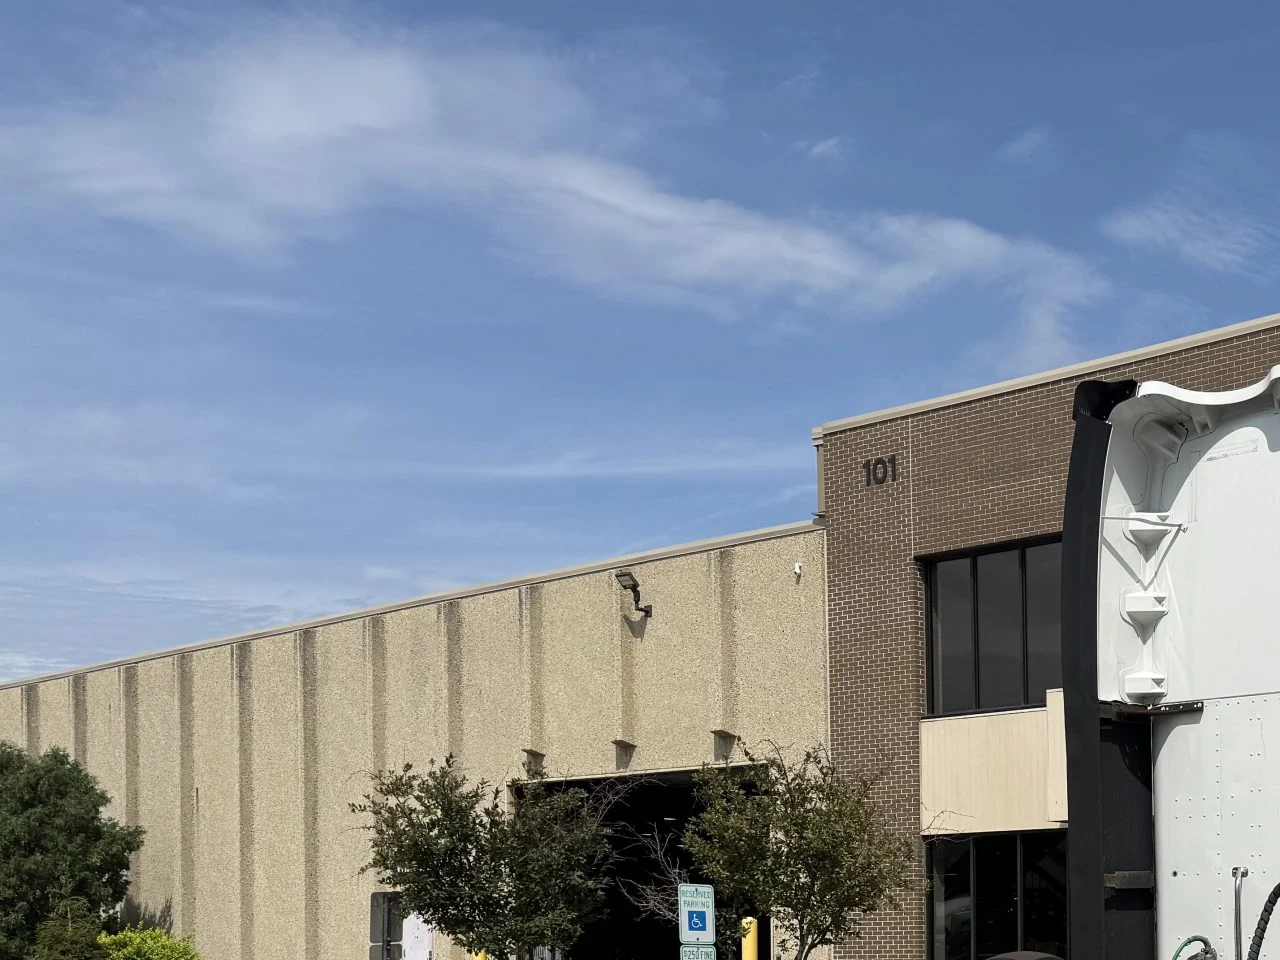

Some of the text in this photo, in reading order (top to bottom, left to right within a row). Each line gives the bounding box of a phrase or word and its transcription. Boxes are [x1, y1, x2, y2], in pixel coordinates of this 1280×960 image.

[863, 454, 896, 487] 101
[681, 889, 711, 899] RESERVED
[683, 901, 710, 909] PARKING
[684, 950, 714, 960] $250 FINE
